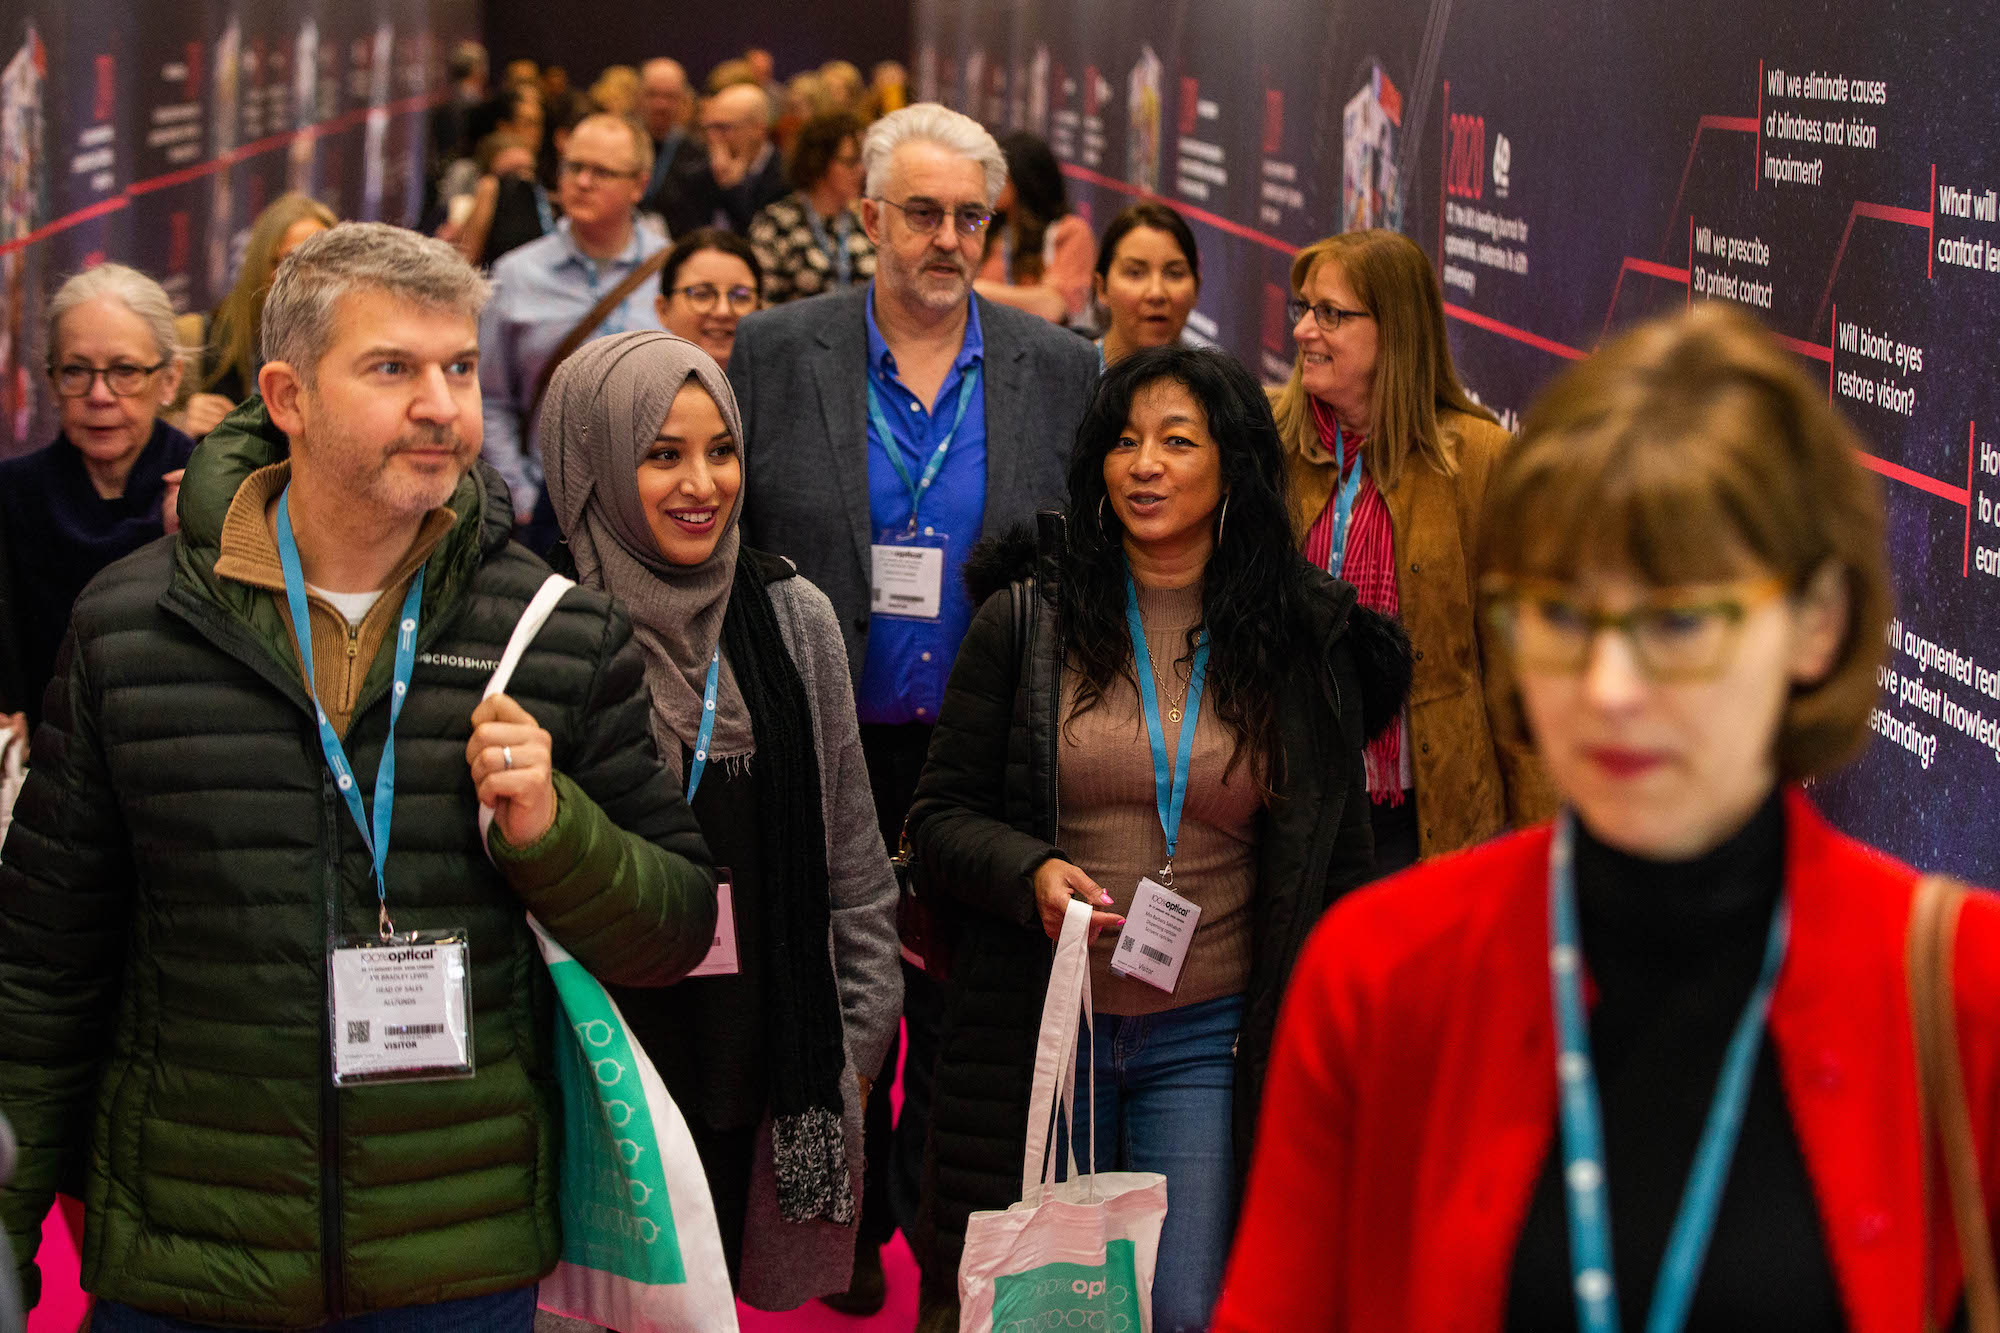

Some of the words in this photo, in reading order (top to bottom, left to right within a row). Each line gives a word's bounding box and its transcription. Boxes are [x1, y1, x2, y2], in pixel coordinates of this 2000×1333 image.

[1767, 68, 1785, 97] Will
[1786, 75, 1801, 99] we
[1803, 70, 1849, 102] eliminate
[1850, 79, 1887, 105] causes
[1766, 109, 1777, 138] of
[1777, 111, 1822, 143] blindness
[1823, 117, 1845, 145] and
[1846, 116, 1877, 149] vision
[1447, 112, 1485, 200] 2020
[1764, 149, 1823, 189] impairment?
[1939, 184, 1972, 218] What
[1973, 189, 1997, 222] will
[1695, 226, 1712, 254] Will
[1713, 234, 1727, 258] we
[1727, 235, 1770, 267] prescribe
[1937, 236, 1983, 270] contact
[1694, 265, 1706, 292] 3D
[1706, 268, 1738, 300] printed
[1738, 278, 1773, 309] contact
[1839, 321, 1859, 354] Will
[1860, 326, 1894, 364] bionic
[1895, 342, 1923, 377] eyes
[1837, 369, 1874, 404] restore
[1876, 376, 1916, 417] vision?
[1979, 441, 2000, 477] Ho
[1977, 489, 1993, 524] to
[1904, 630, 1974, 687] augmented
[1899, 675, 1942, 719] patient
[384, 1040, 418, 1050] VISITOR
